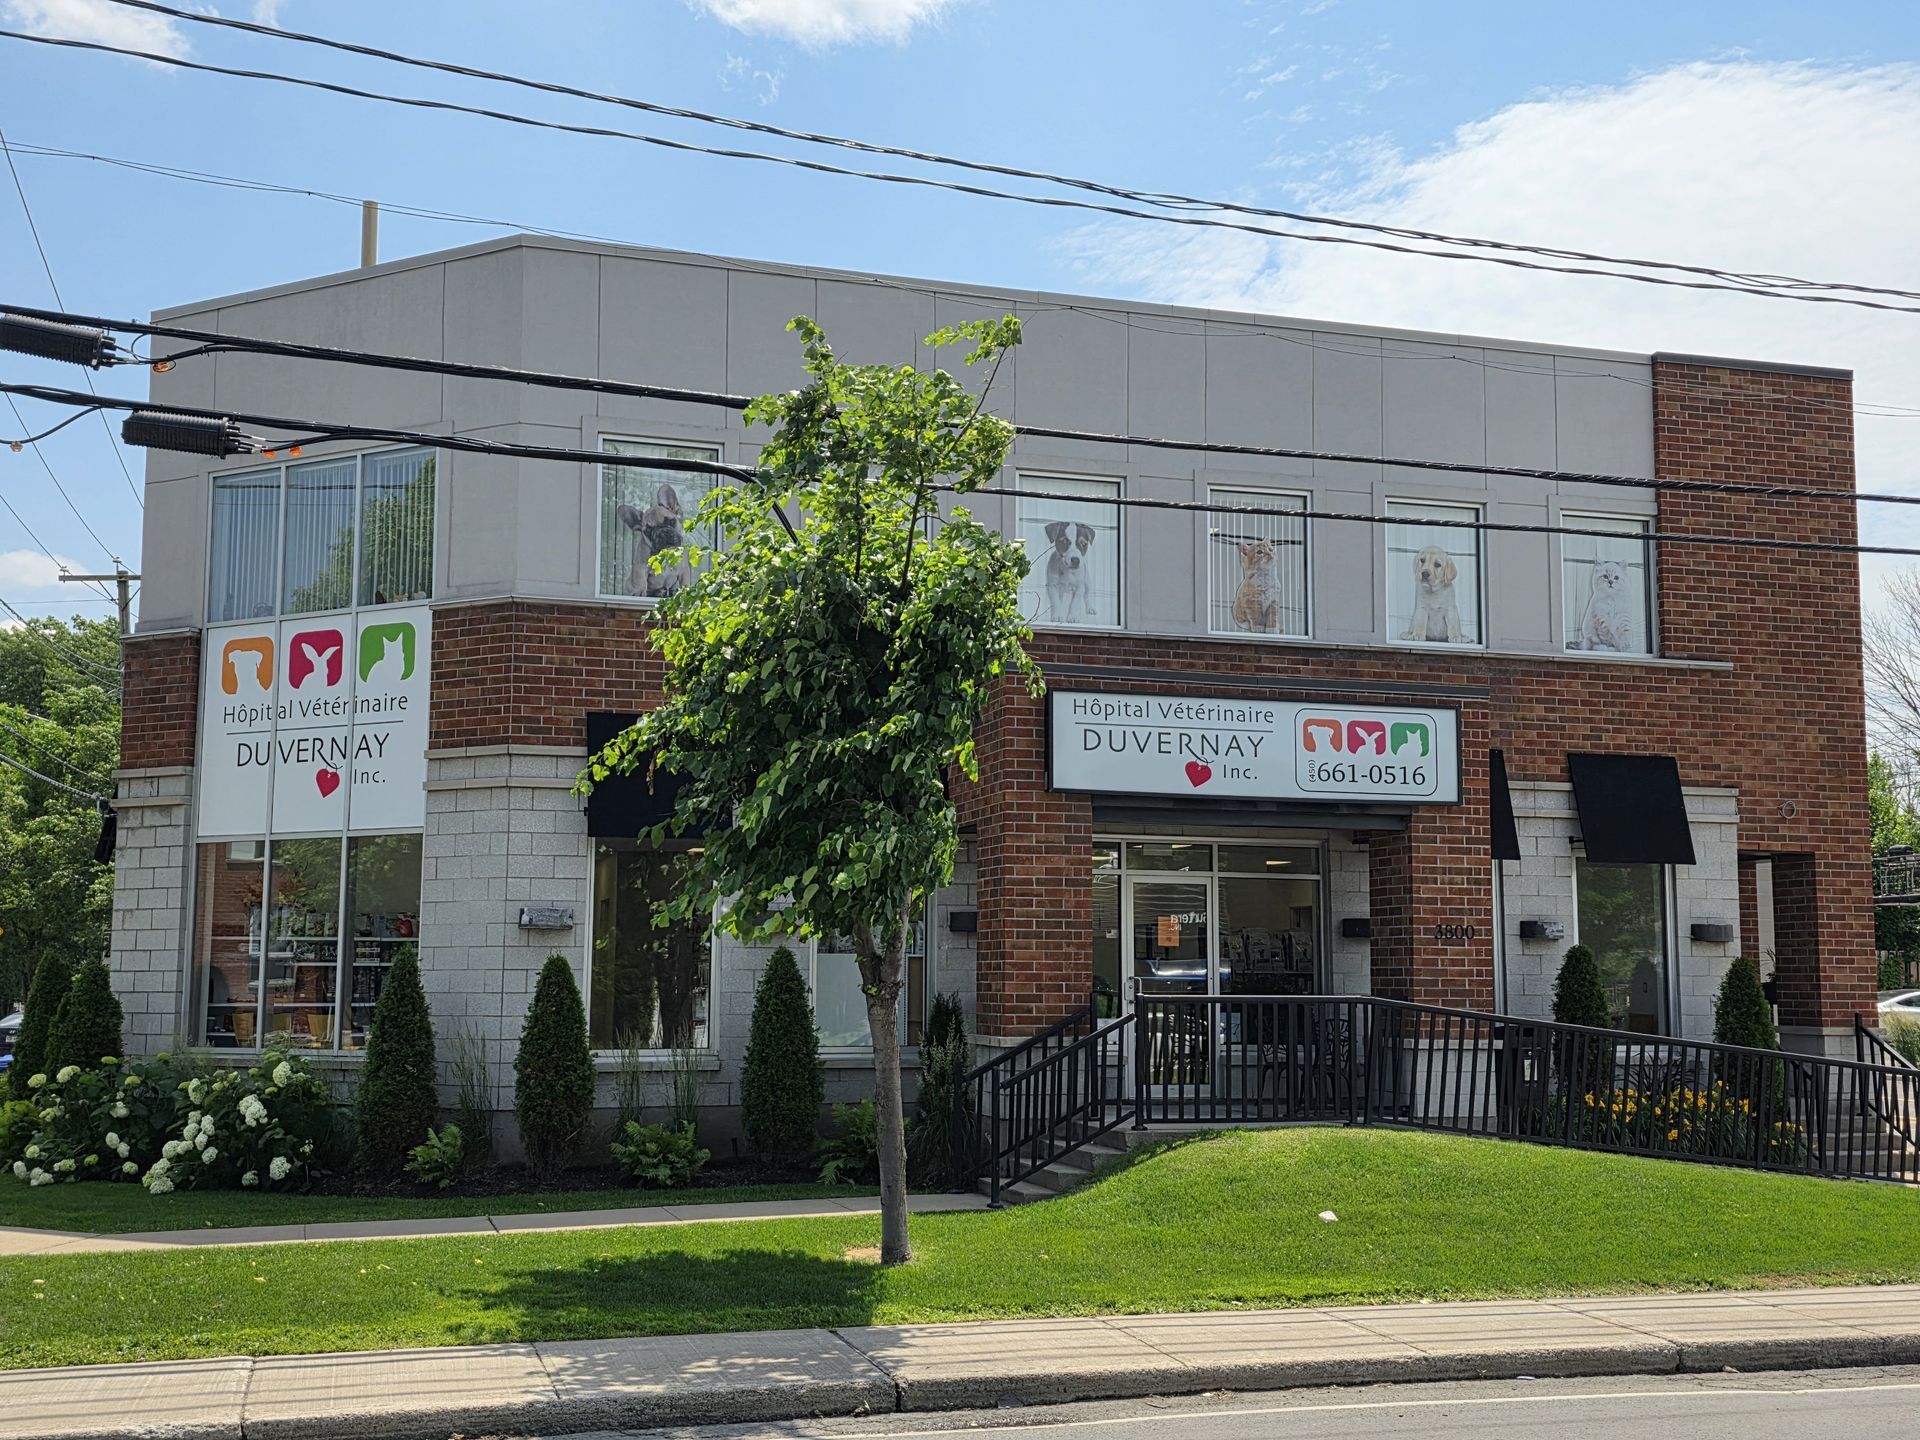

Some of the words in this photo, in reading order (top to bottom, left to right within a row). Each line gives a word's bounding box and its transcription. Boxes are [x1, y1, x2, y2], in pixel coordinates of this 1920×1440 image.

[223, 699, 293, 727] Hôpital
[298, 693, 408, 718] Vétérinaire
[1073, 698, 1150, 721] Hôpital
[1157, 701, 1274, 724] Vétérinaire
[237, 733, 389, 769] DUVERNAY
[1083, 728, 1265, 763] DUVERNAY
[353, 768, 387, 785] Inc.
[1222, 764, 1259, 780] Inc.
[1308, 759, 1317, 782] (450)
[1317, 761, 1426, 786] 661-0516
[1434, 924, 1475, 940] 3800
